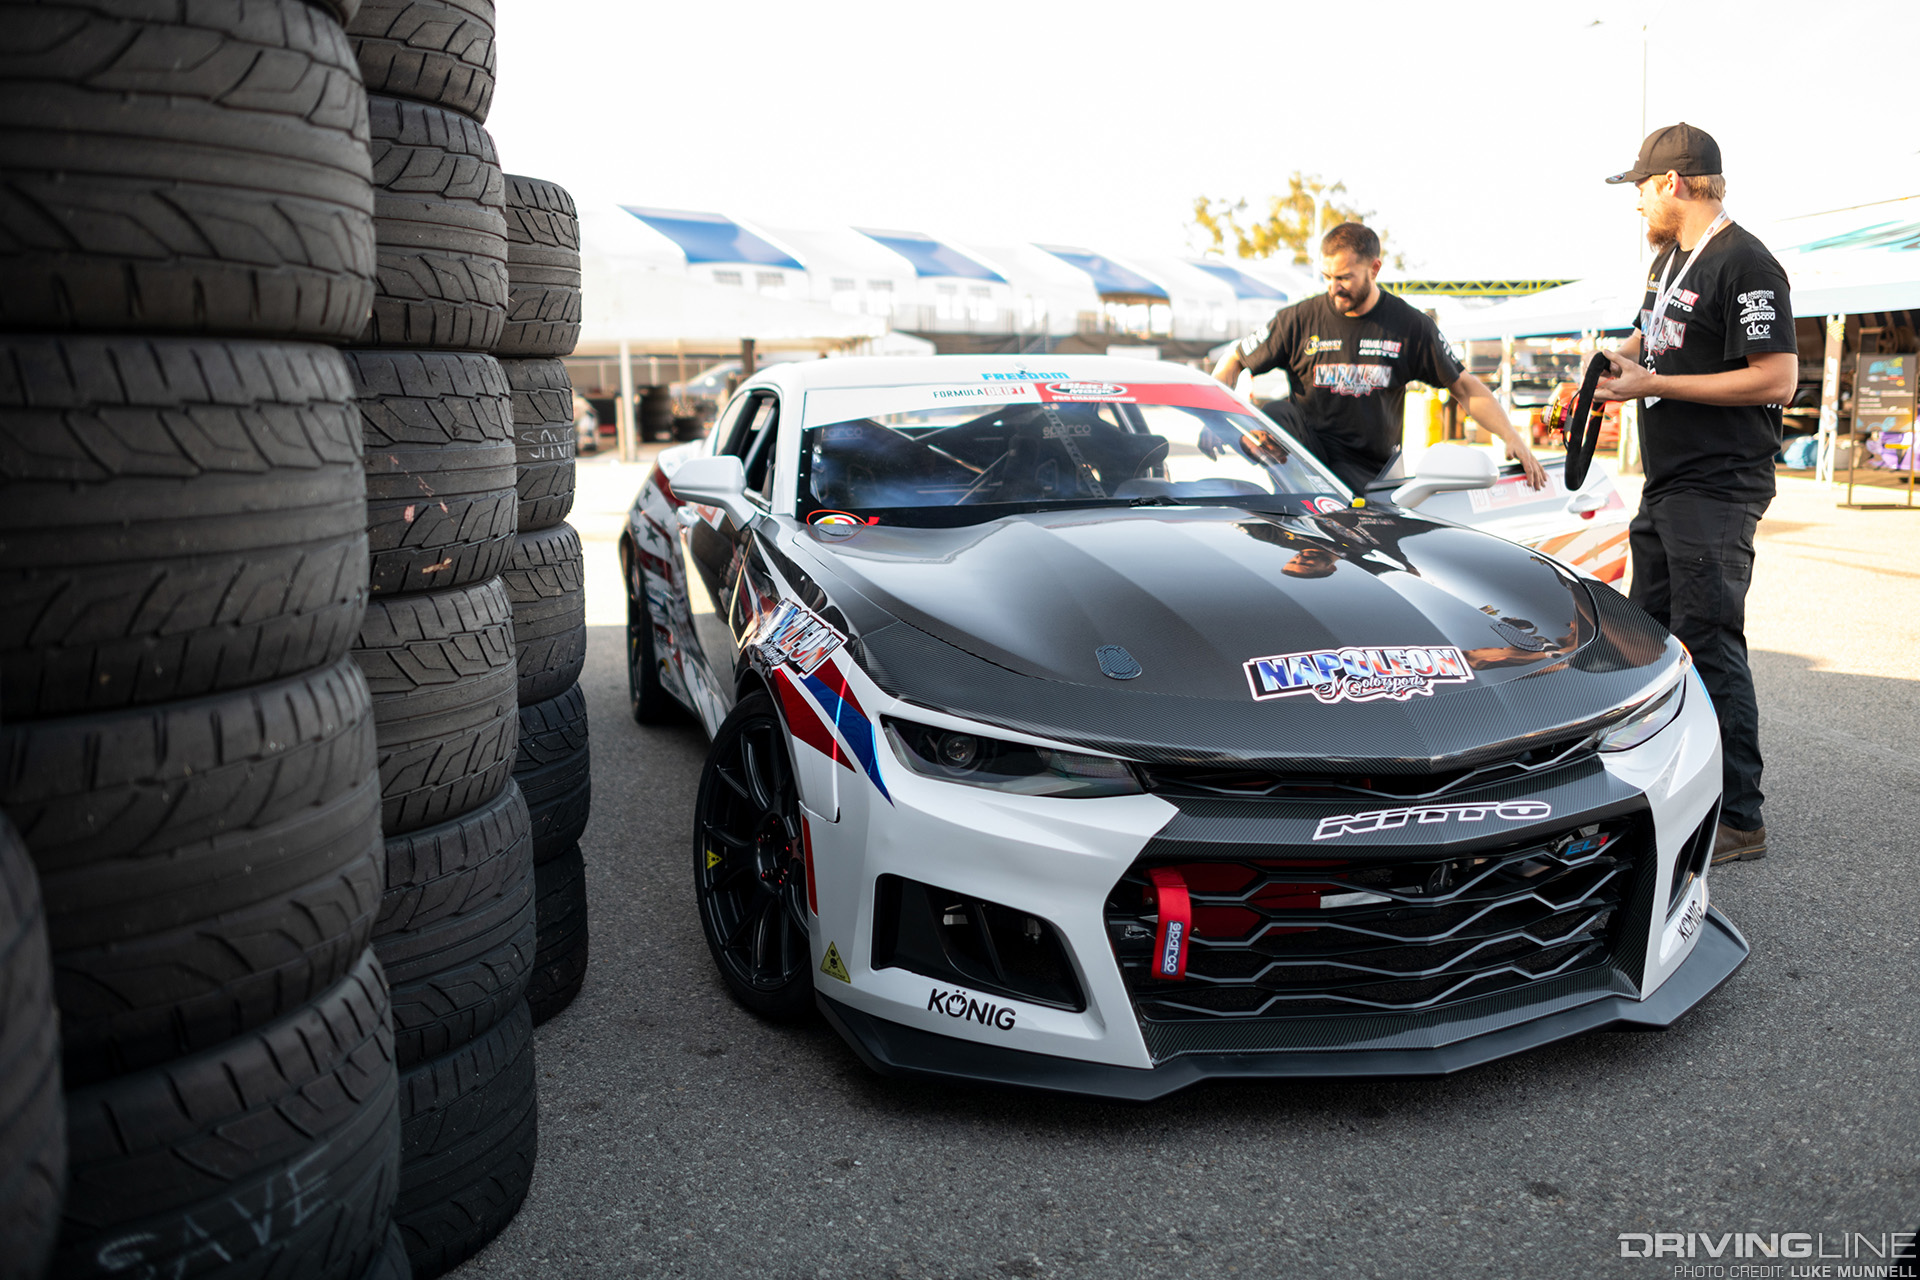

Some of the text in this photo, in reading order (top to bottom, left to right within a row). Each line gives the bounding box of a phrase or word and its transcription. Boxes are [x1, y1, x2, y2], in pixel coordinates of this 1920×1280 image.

[1746, 321, 1770, 335] dce
[933, 386, 1026, 399] FORMULA DRIFT
[1314, 364, 1391, 387] NAPOLEON
[1256, 649, 1467, 692] NAPOLEON
[1313, 675, 1428, 697] Motorsports
[1312, 801, 1552, 840] NITTO
[1164, 921, 1182, 973] sparco
[927, 988, 1016, 1031] KÖNIG
[97, 1143, 331, 1280] SAVE
